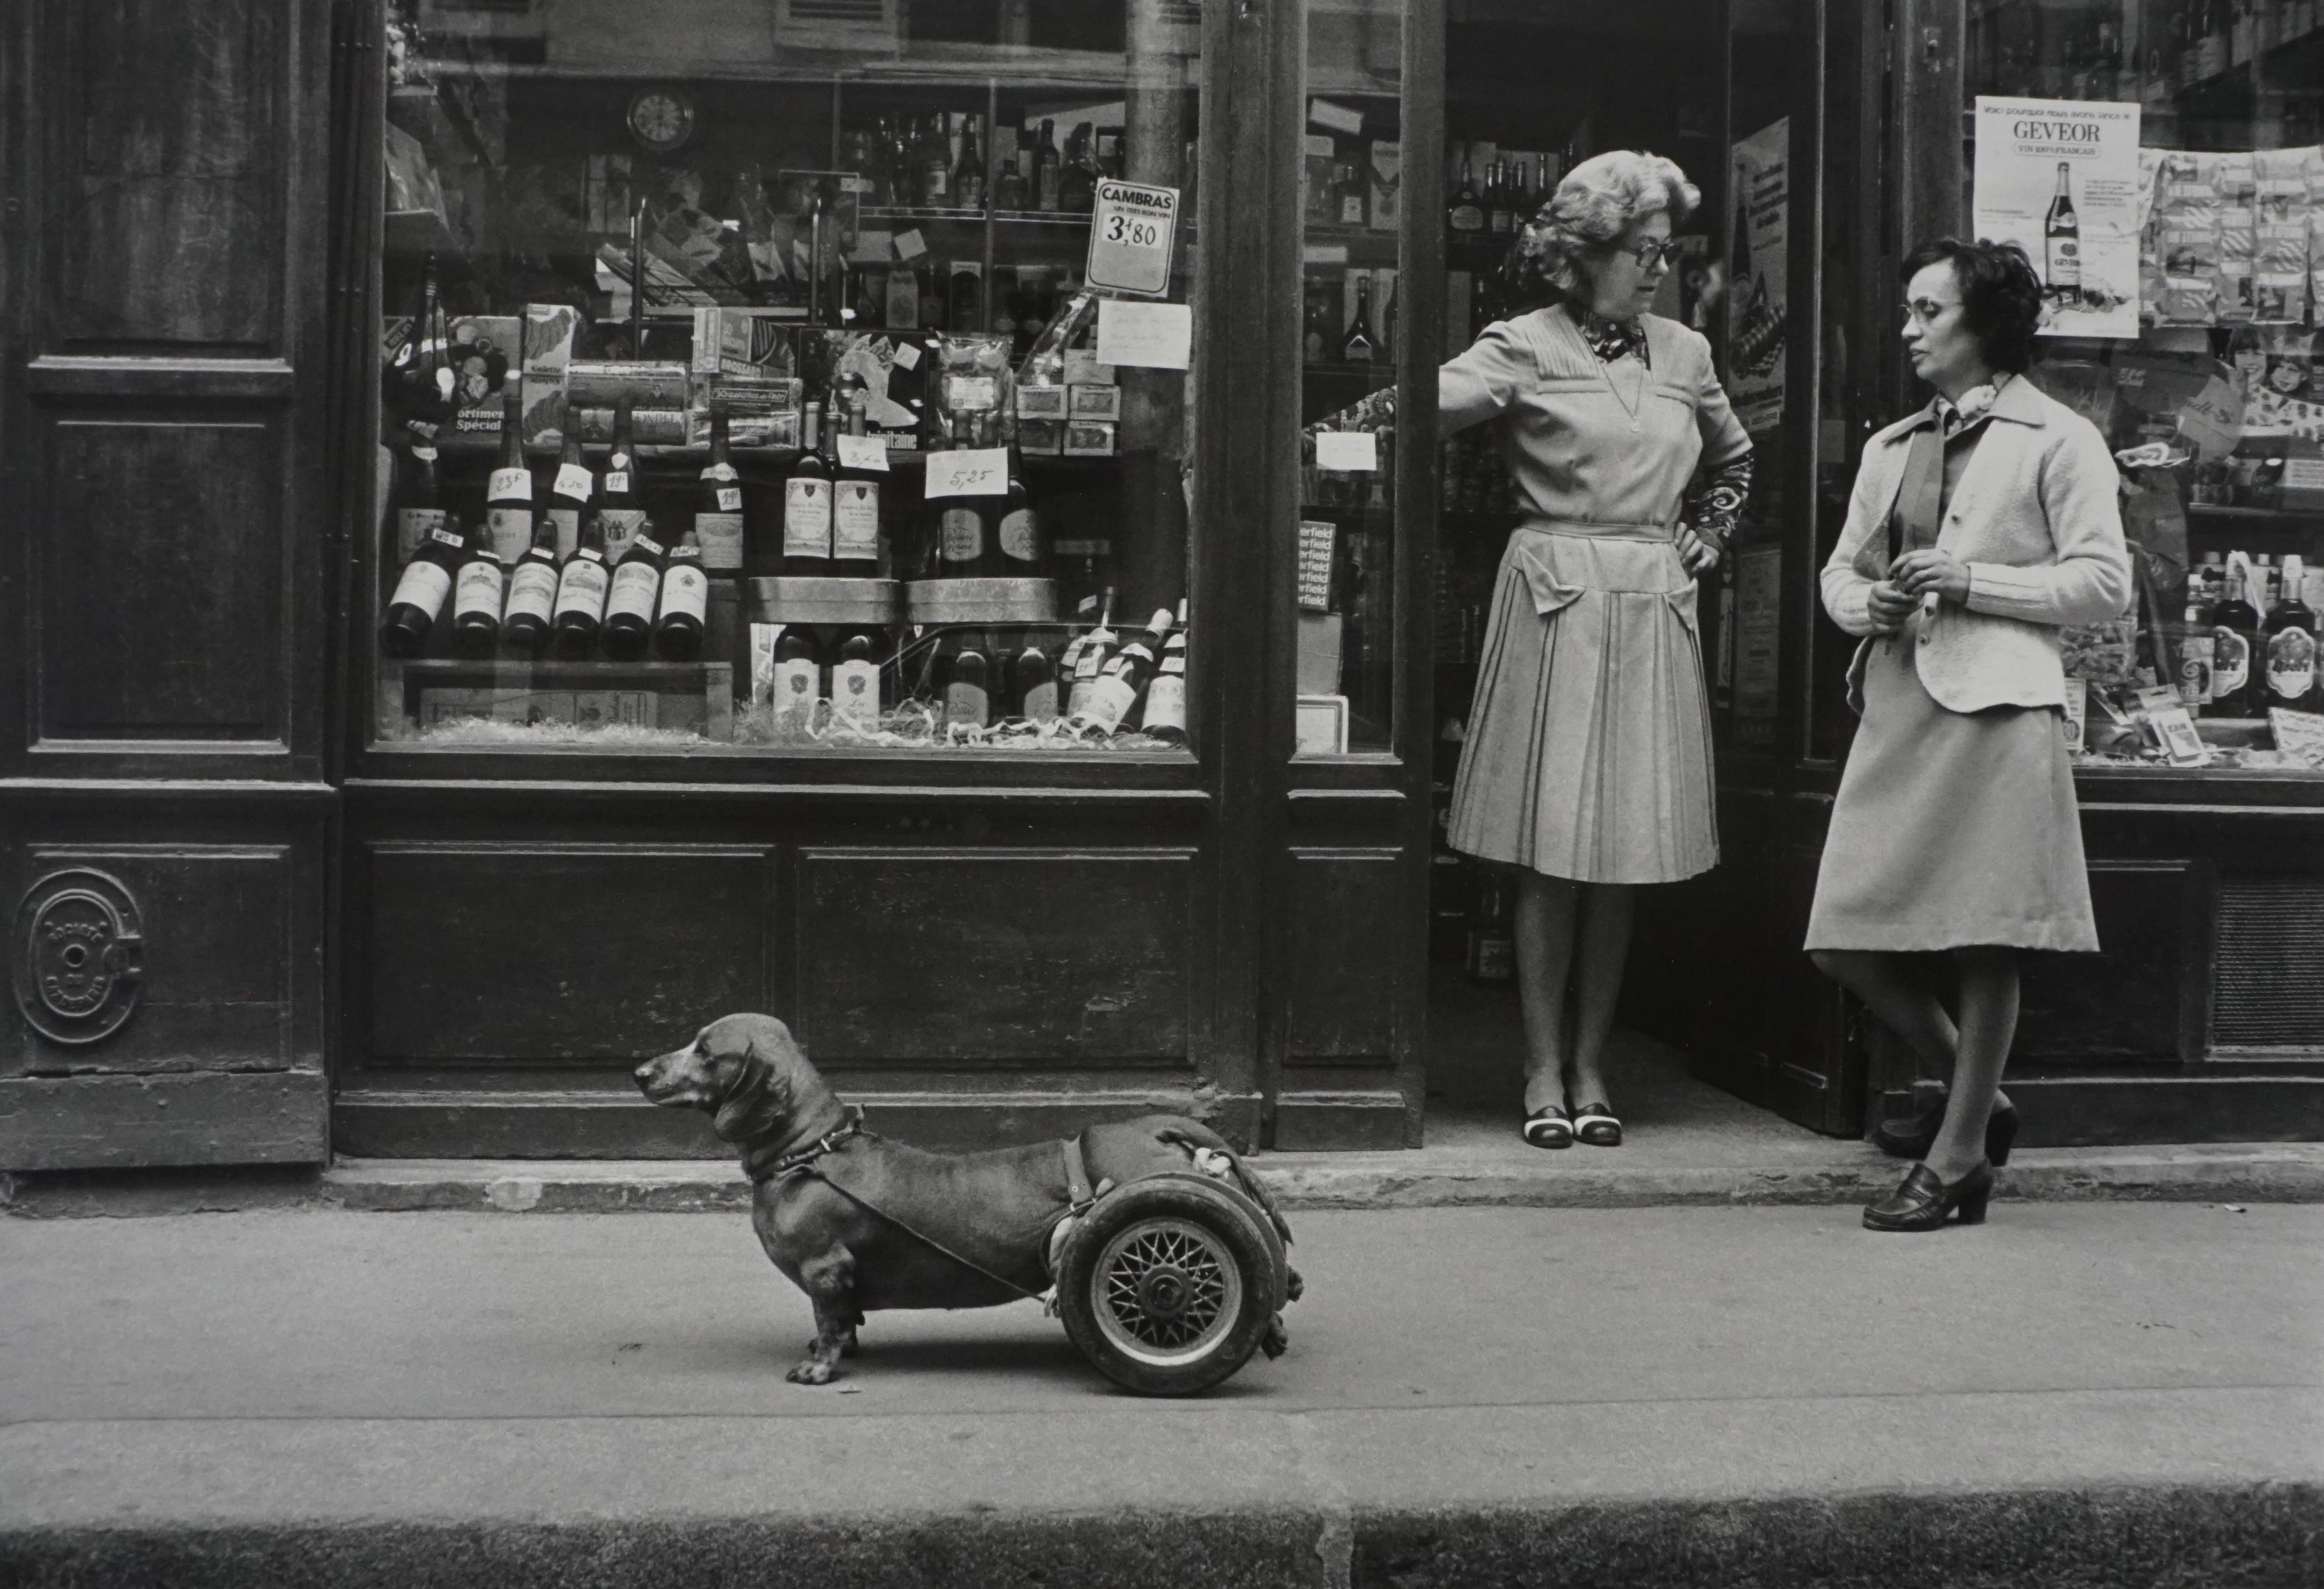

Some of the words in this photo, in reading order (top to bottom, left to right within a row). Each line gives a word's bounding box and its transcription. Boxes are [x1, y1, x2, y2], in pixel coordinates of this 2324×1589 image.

[2046, 110, 2068, 118] nous
[2070, 110, 2096, 119] avons
[2014, 121, 2101, 142] GEVEOR
[1102, 188, 1172, 209] CAMBRAS
[867, 430, 917, 449] itaine
[1299, 527, 1333, 539] erfield
[1299, 538, 1331, 550] erfield
[1298, 550, 1330, 561] erfield
